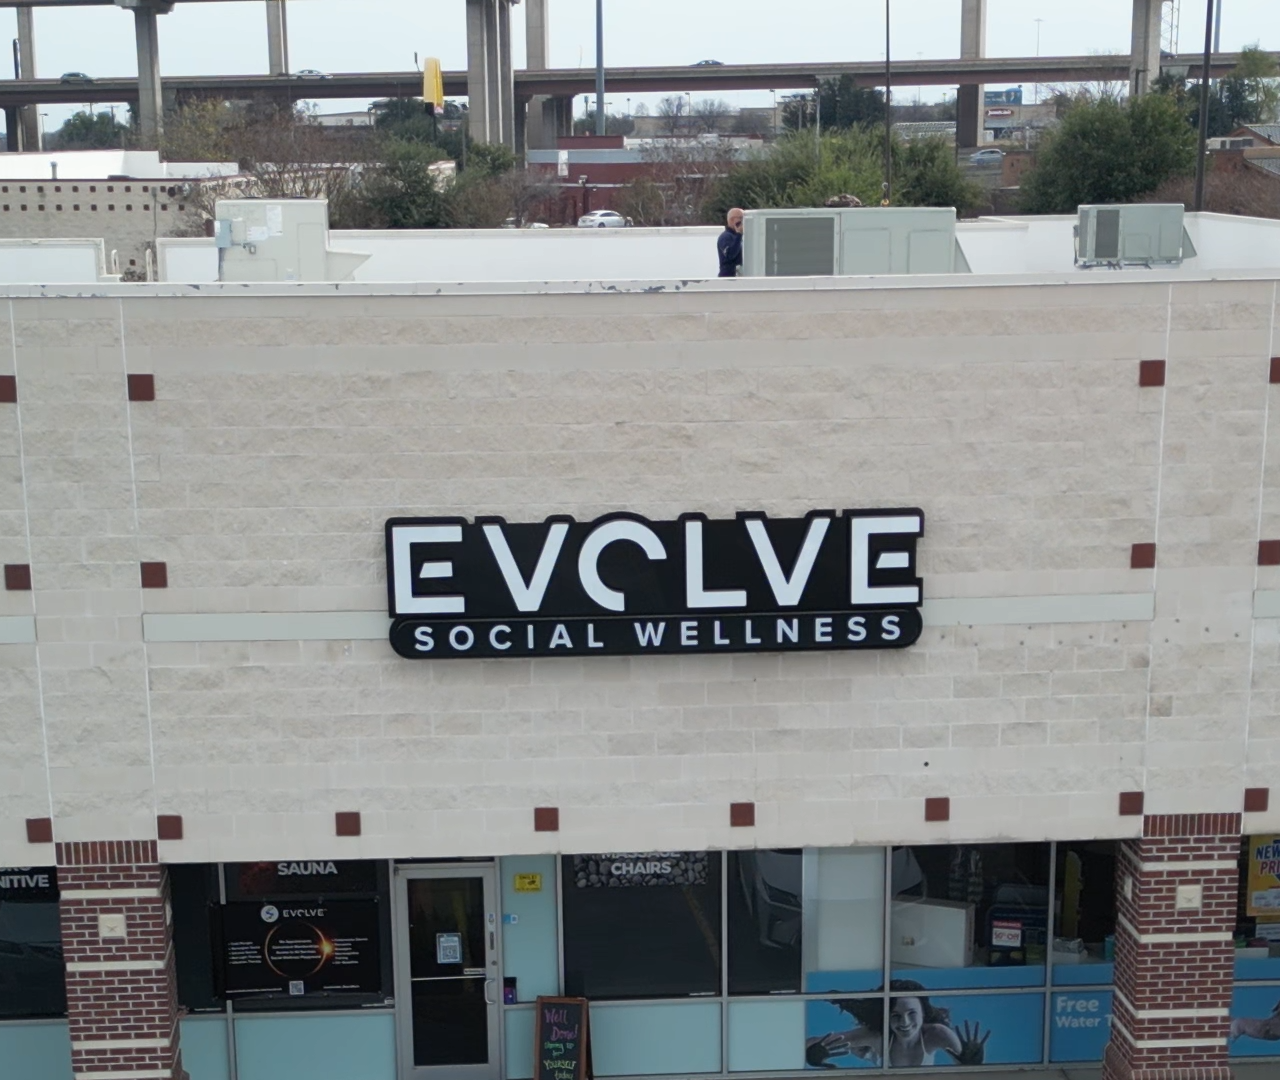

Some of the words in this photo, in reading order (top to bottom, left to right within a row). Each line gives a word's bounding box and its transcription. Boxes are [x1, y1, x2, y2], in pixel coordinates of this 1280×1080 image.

[392, 516, 920, 614] EVOLVE
[414, 622, 605, 652] SOCIAL
[634, 614, 902, 648] WELLNESS
[278, 862, 338, 876] SAUNA
[611, 861, 672, 875] CHAIRS
[1056, 996, 1100, 1013] Free
[544, 1008, 569, 1024] Well
[1055, 1016, 1101, 1029] Water
